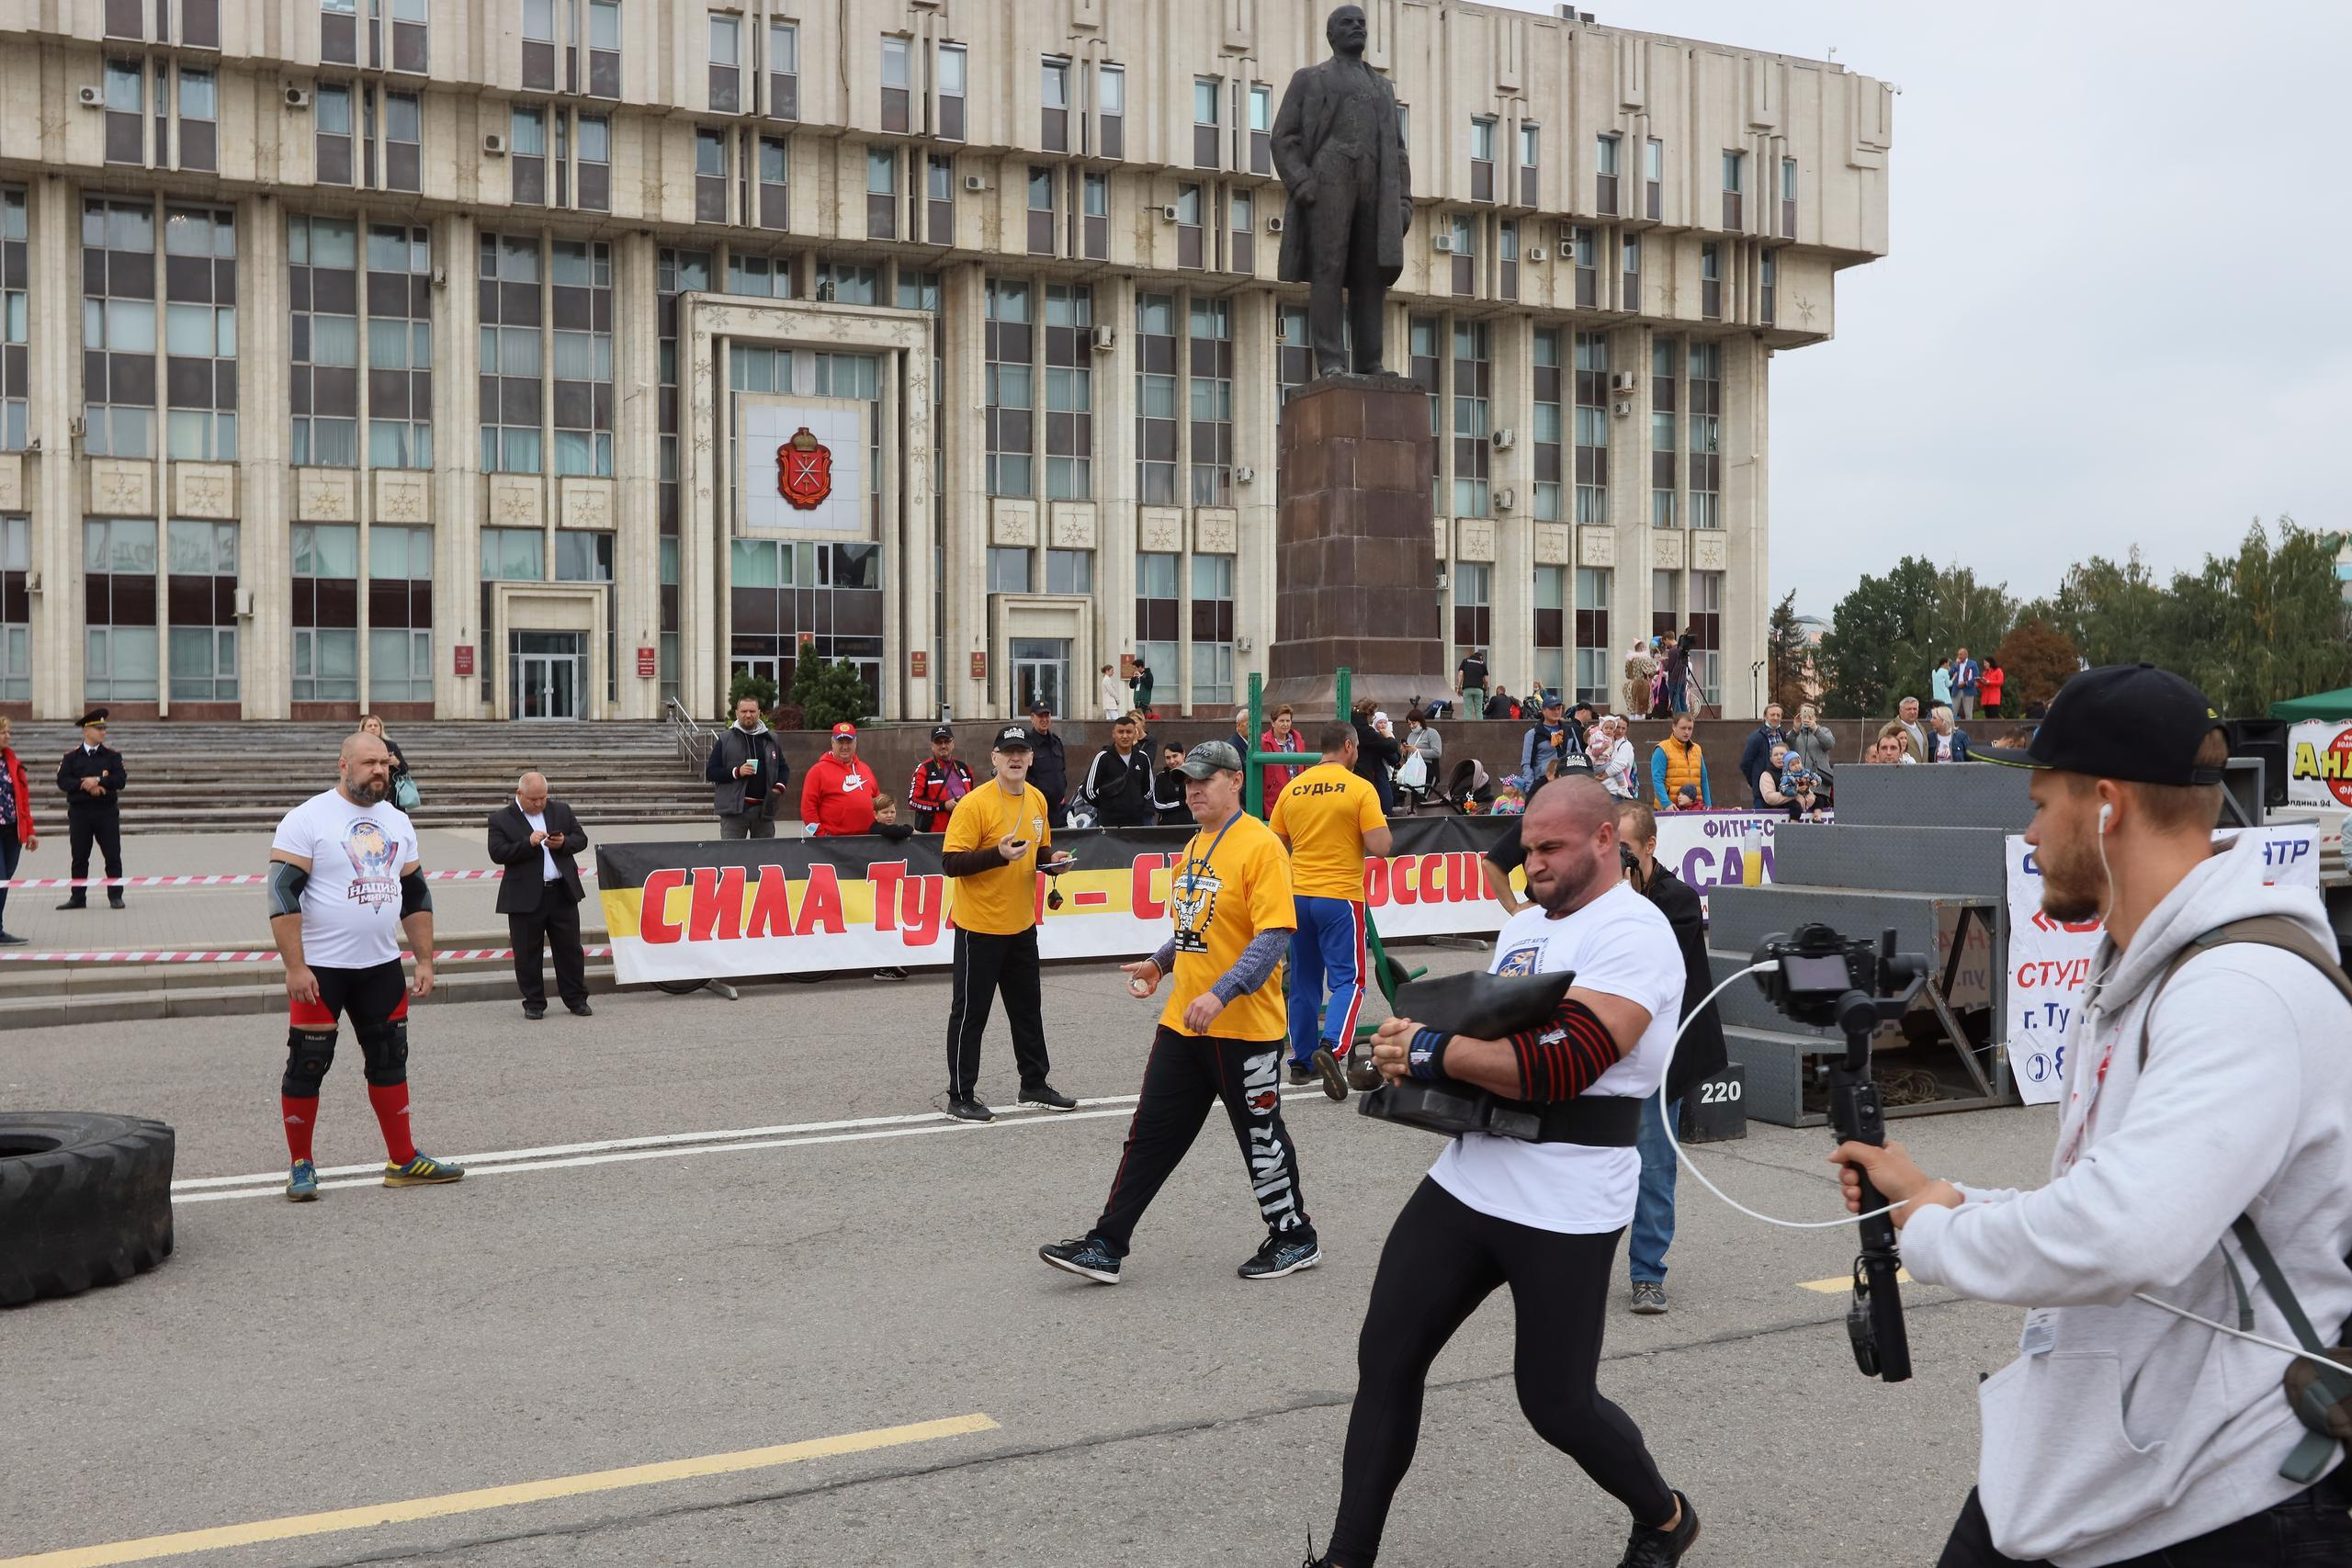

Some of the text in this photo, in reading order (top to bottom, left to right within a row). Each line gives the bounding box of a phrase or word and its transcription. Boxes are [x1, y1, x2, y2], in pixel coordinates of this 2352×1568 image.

[1292, 782, 1346, 796] СУДЬЯ
[2320, 799, 2331, 807] 94
[348, 882, 398, 898] НАЦИЯ
[359, 893, 392, 905] МИРА
[639, 863, 848, 945] СИЛА
[2024, 1010, 2038, 1030] г.
[1701, 1080, 1741, 1104] 220
